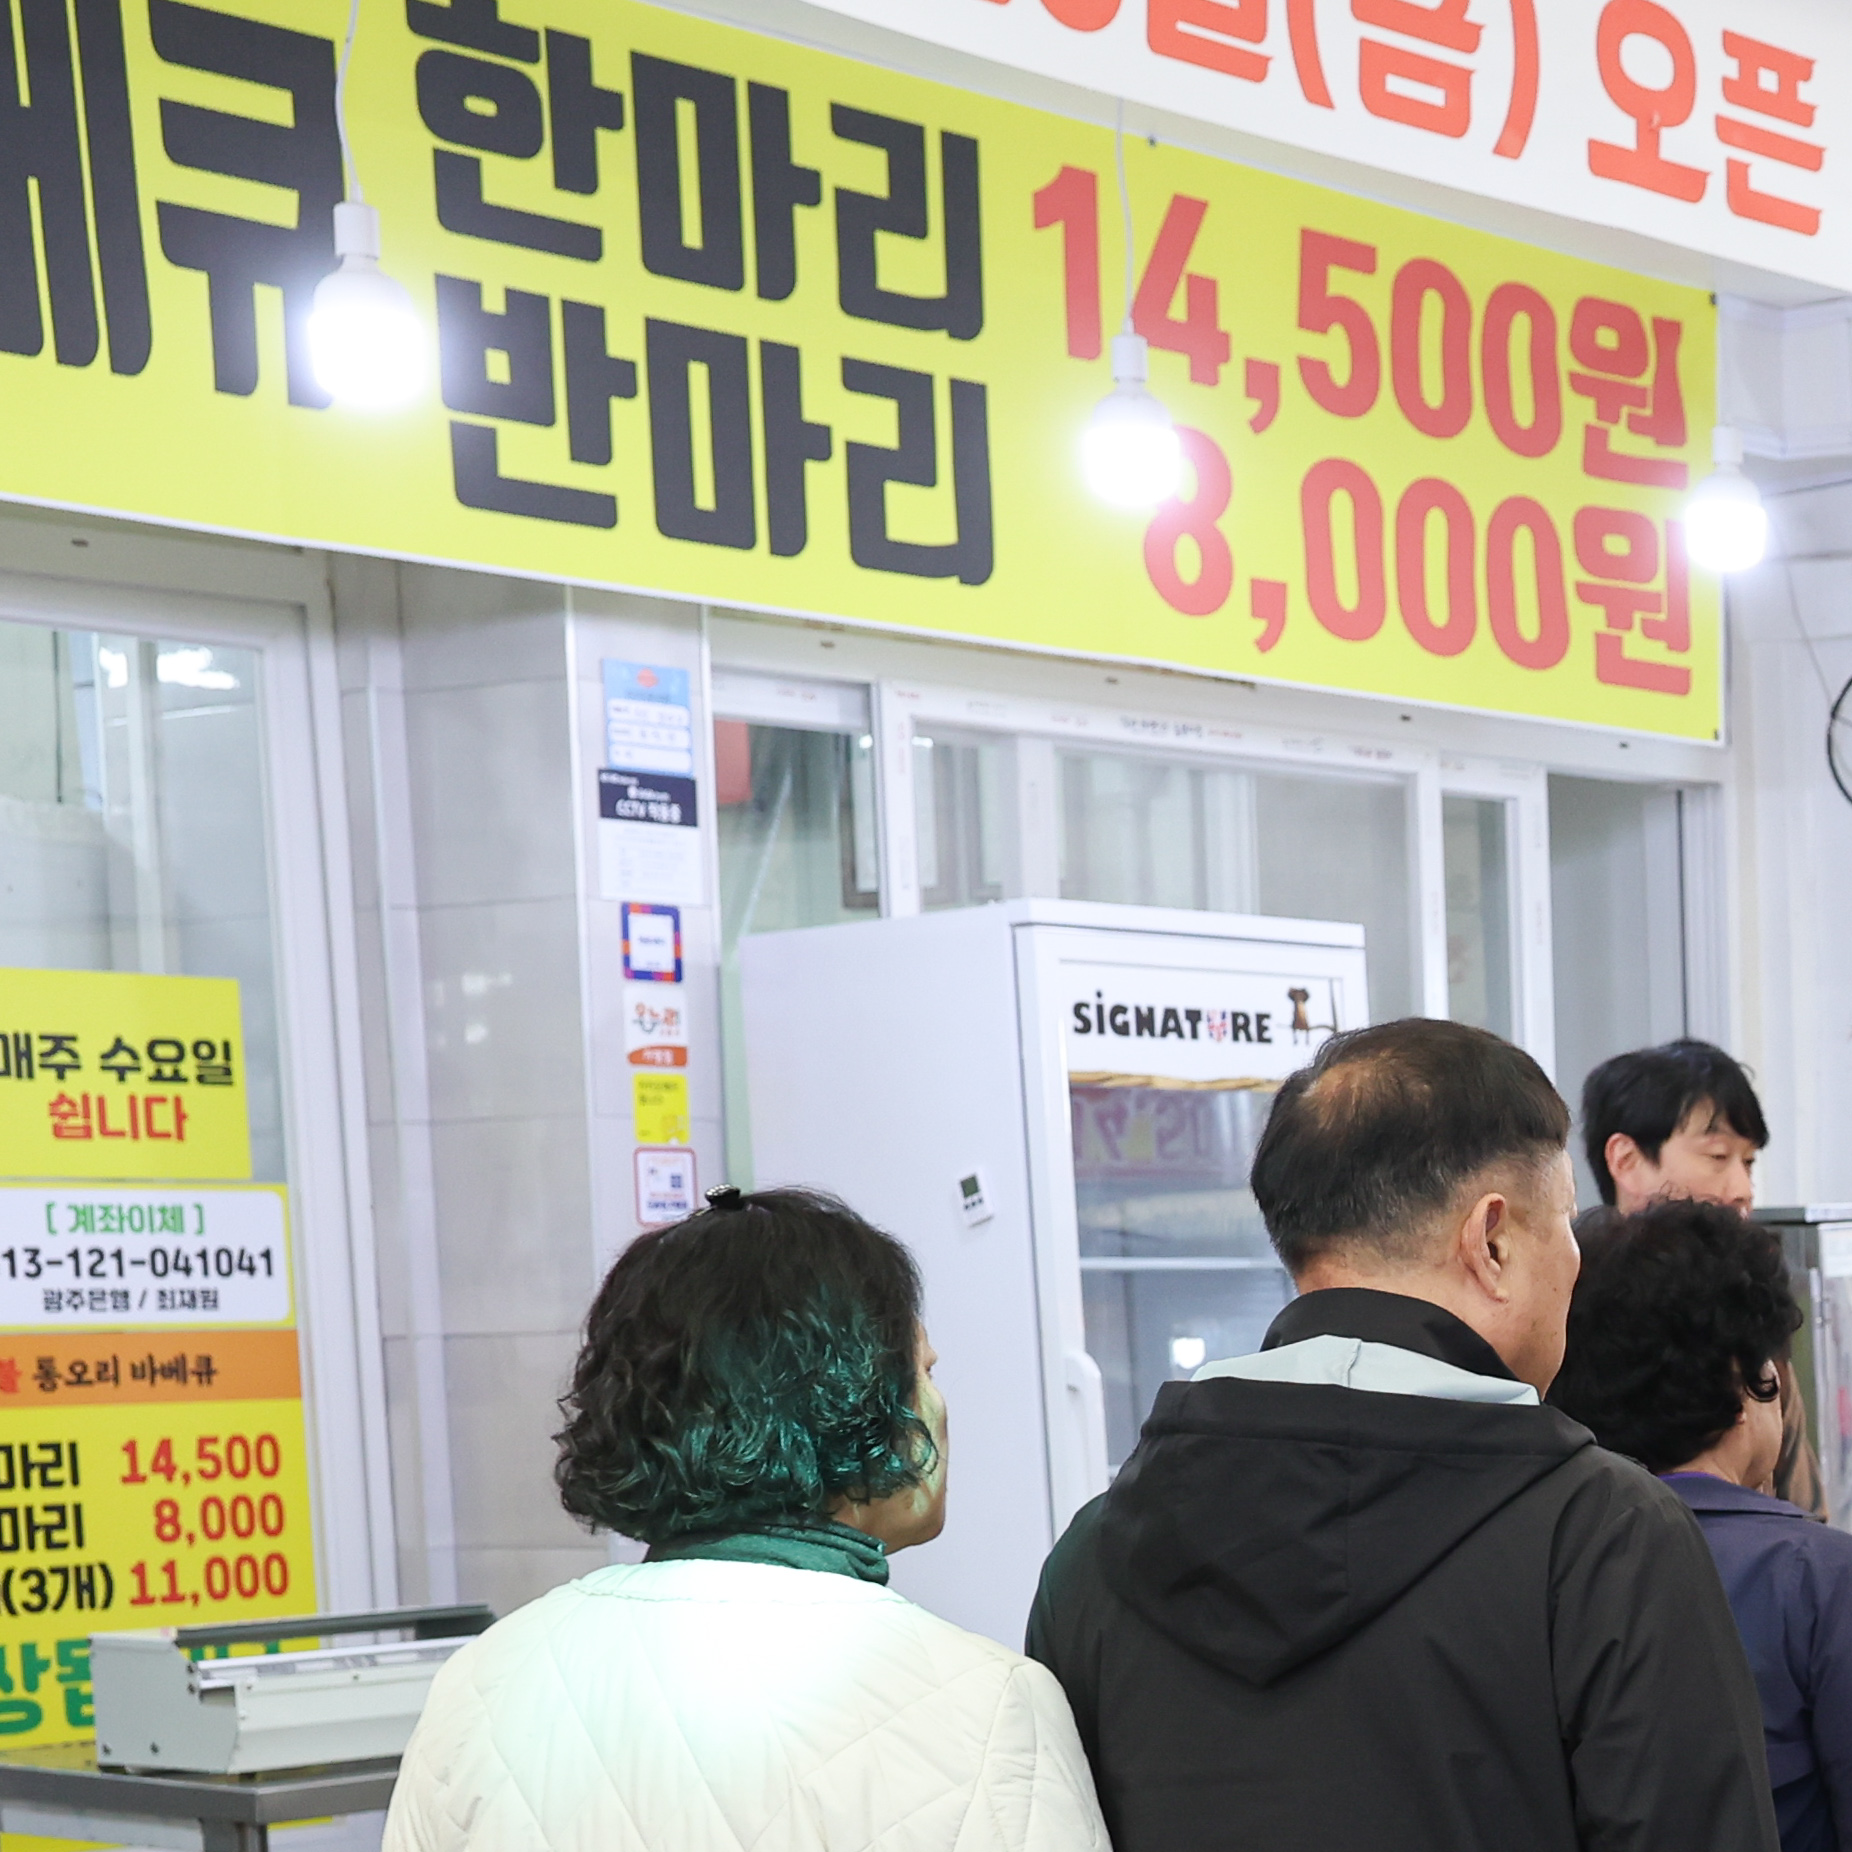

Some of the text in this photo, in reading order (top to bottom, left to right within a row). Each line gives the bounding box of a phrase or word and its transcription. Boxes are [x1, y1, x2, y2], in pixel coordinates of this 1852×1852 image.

[1587, 0, 1827, 237] 오픈
[406, 0, 1690, 491] 한마리 14,500원
[433, 272, 1694, 697] 반마리 8,000원
[99, 1035, 234, 1086] 수요일
[48, 1091, 189, 1142] 쉽니다
[67, 1203, 185, 1234] 계좌이체
[33, 1353, 120, 1393] 통오리
[130, 1352, 218, 1388] 바베큐
[120, 1432, 281, 1486] 14,500
[154, 1492, 284, 1547] 8,000
[129, 1551, 290, 1606] 11,000
